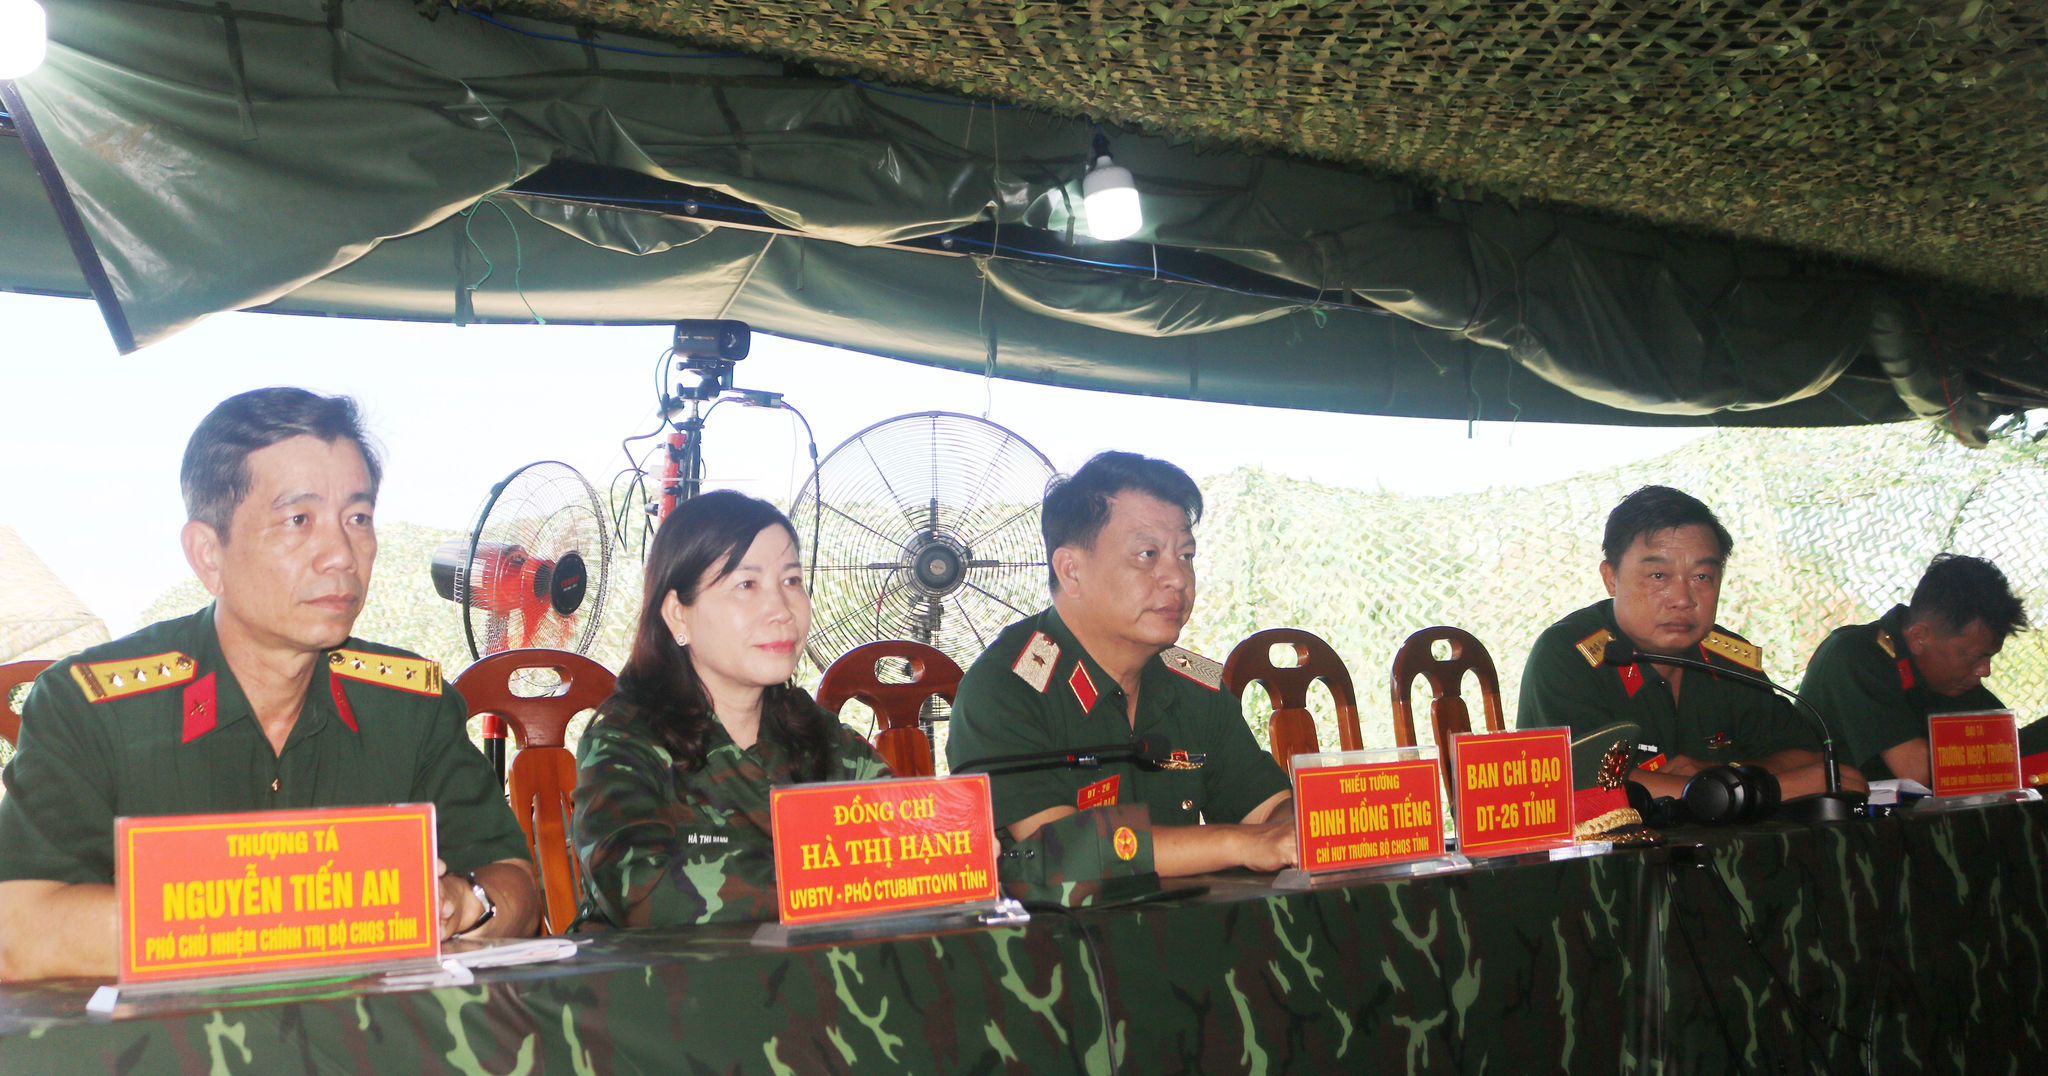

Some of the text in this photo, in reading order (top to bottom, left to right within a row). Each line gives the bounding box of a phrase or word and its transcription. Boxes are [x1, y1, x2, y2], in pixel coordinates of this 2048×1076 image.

[1339, 771, 1400, 794] THIẾU TƯỚNG
[1467, 750, 1561, 790] BAN CHỈ ĐẠO
[834, 792, 936, 826] ĐỒNG CHÍ
[1309, 792, 1432, 838] ĐINH HỒNG TIẾNG
[1476, 791, 1556, 832] DT-26 TỈNH
[226, 825, 339, 860] THƯỢNG TÁ
[801, 829, 972, 871] HÀ THỊ HẠNH
[1316, 832, 1429, 864] CHỈ HUY TRƯỞNG BỘ CHQS TỈNH
[163, 859, 400, 922] NGUYỄN TIẾN AN
[790, 885, 834, 910] UVBTV
[845, 876, 872, 903] PHÓ
[873, 874, 958, 901] CTUBMTTQVN
[959, 864, 988, 890] TỈNH
[146, 910, 418, 961] PHÓ CHỦ NHIỆM CHÍNH TRỊ BỘ CHQS TỈNH
